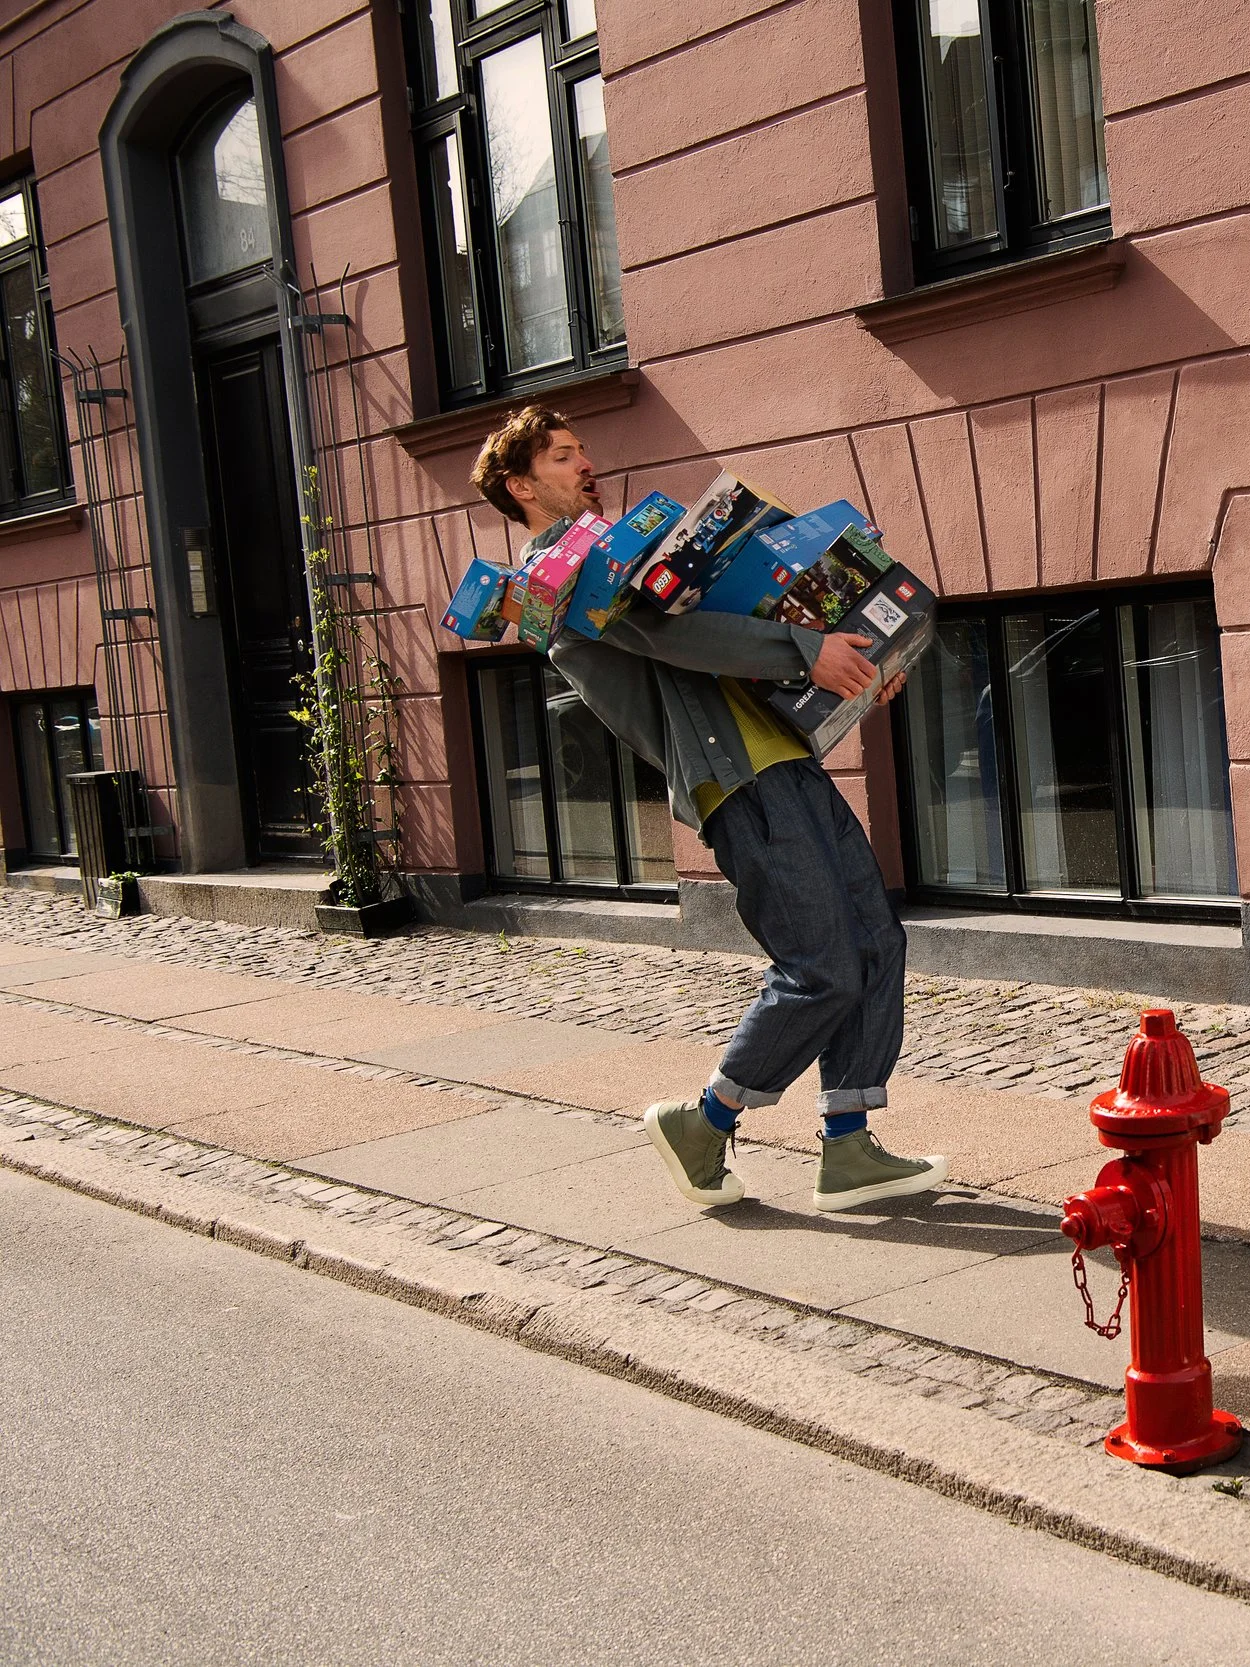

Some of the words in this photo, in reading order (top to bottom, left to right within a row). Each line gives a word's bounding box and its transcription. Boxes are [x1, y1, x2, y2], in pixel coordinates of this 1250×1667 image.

[240, 226, 255, 252] 84
[653, 569, 673, 595] LEGO
[795, 687, 815, 709] GREAT
